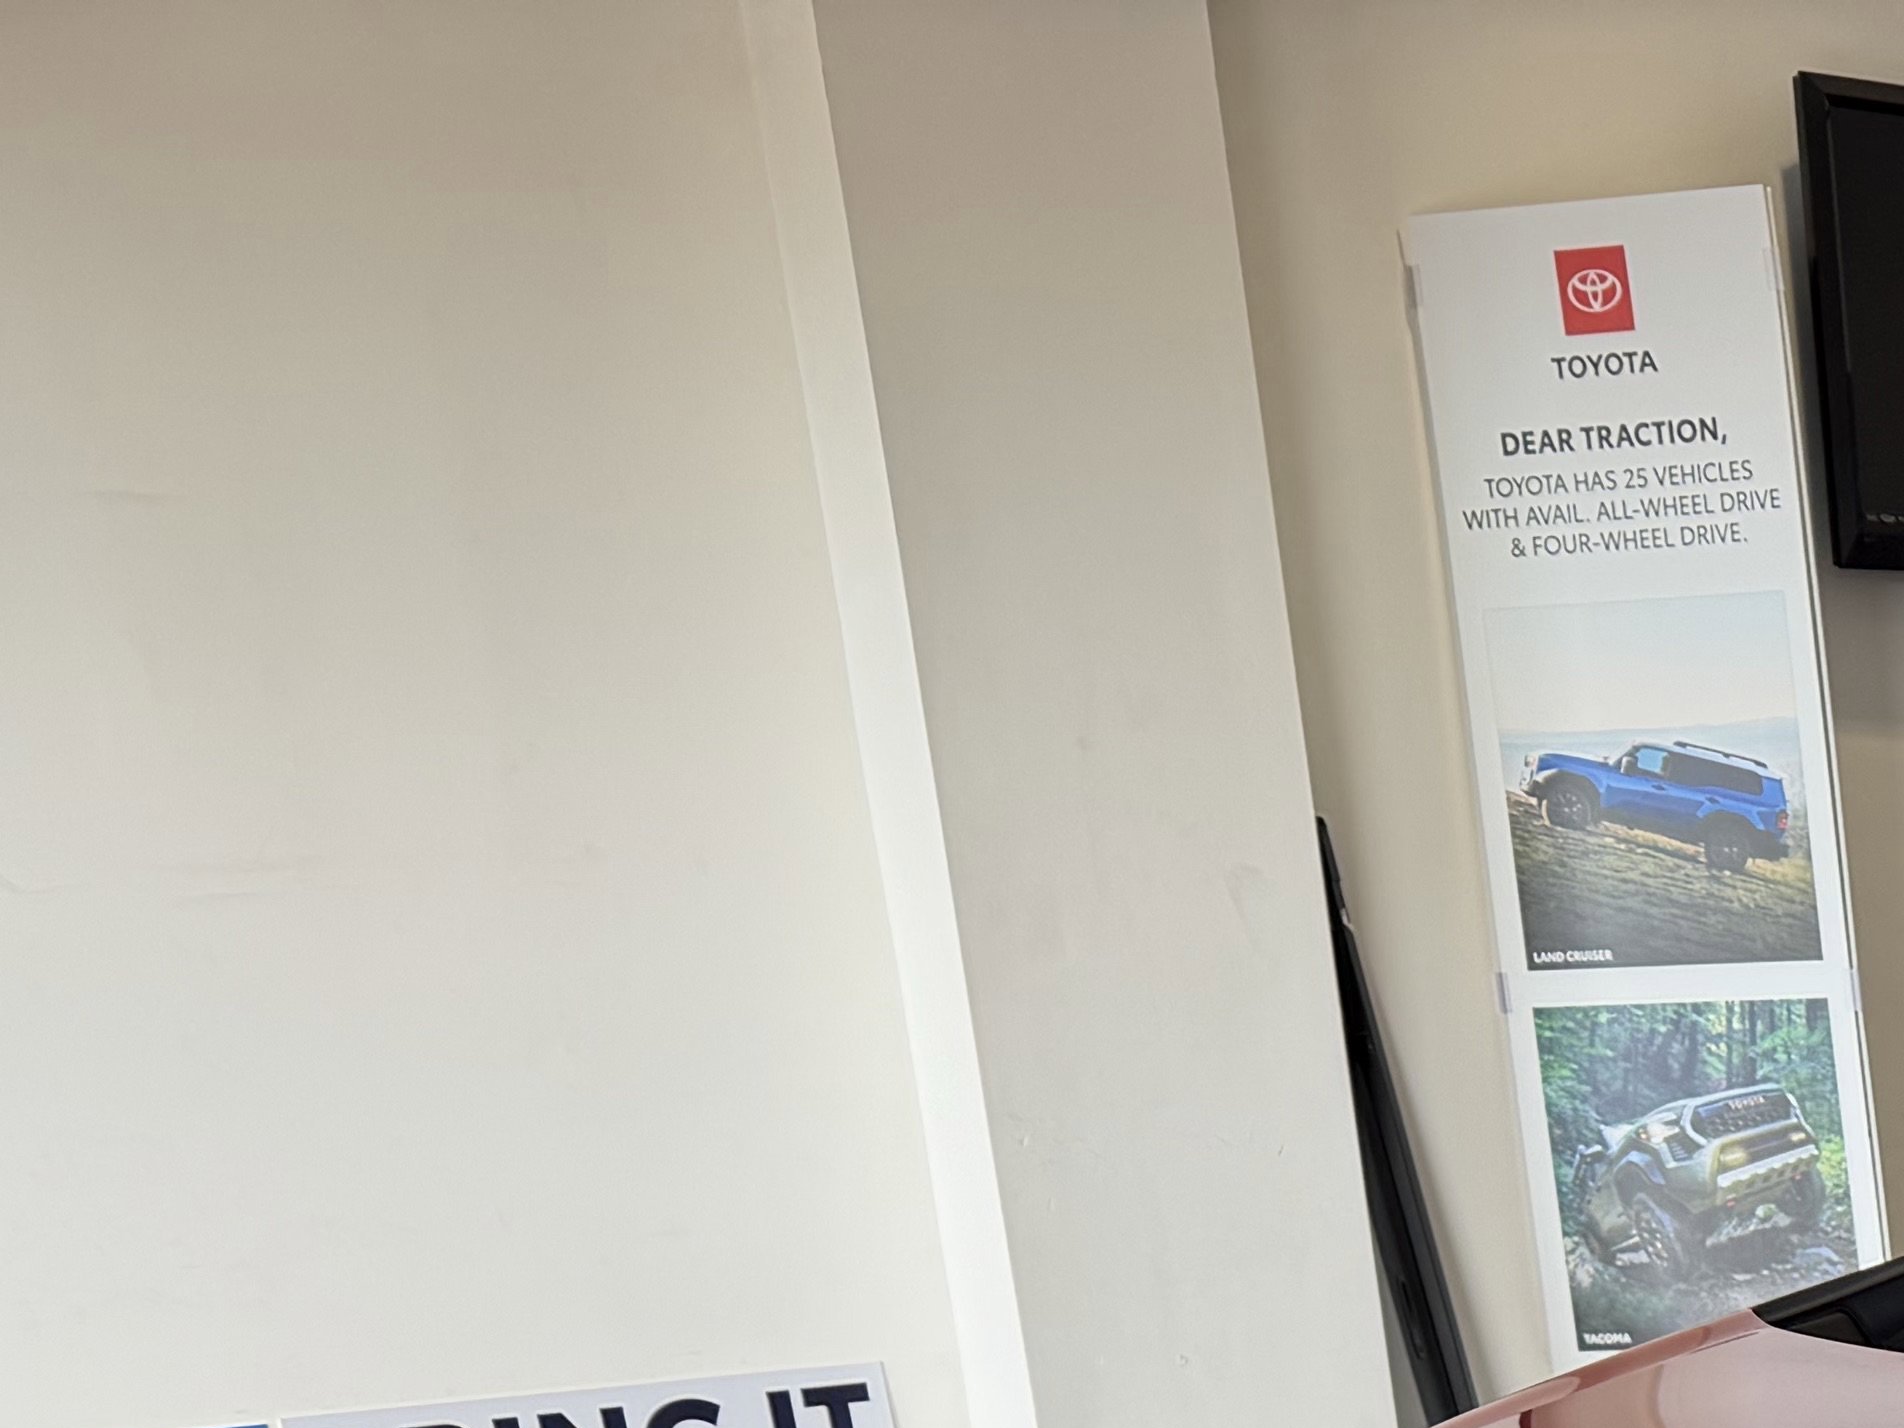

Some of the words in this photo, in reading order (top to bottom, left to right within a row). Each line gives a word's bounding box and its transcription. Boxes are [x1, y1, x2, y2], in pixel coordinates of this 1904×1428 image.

[1551, 349, 1659, 381] TOYOTA
[1500, 427, 1575, 458] DEAR
[1579, 416, 1729, 452] TRACTION,
[1483, 471, 1570, 499] TOYOTA
[1573, 470, 1618, 494] HAS
[1622, 467, 1649, 490] 25
[1652, 459, 1754, 487] VEHICLES
[1462, 506, 1521, 531] WITH
[1525, 503, 1592, 528] AVAIL.
[1596, 493, 1716, 522] ALL-WHEEL
[1719, 487, 1783, 515] DRIVE
[1510, 536, 1528, 560] &
[1532, 528, 1676, 557] FOUR-WHEEL
[1679, 522, 1749, 549] DRIVE.
[1532, 951, 1566, 963] LAND
